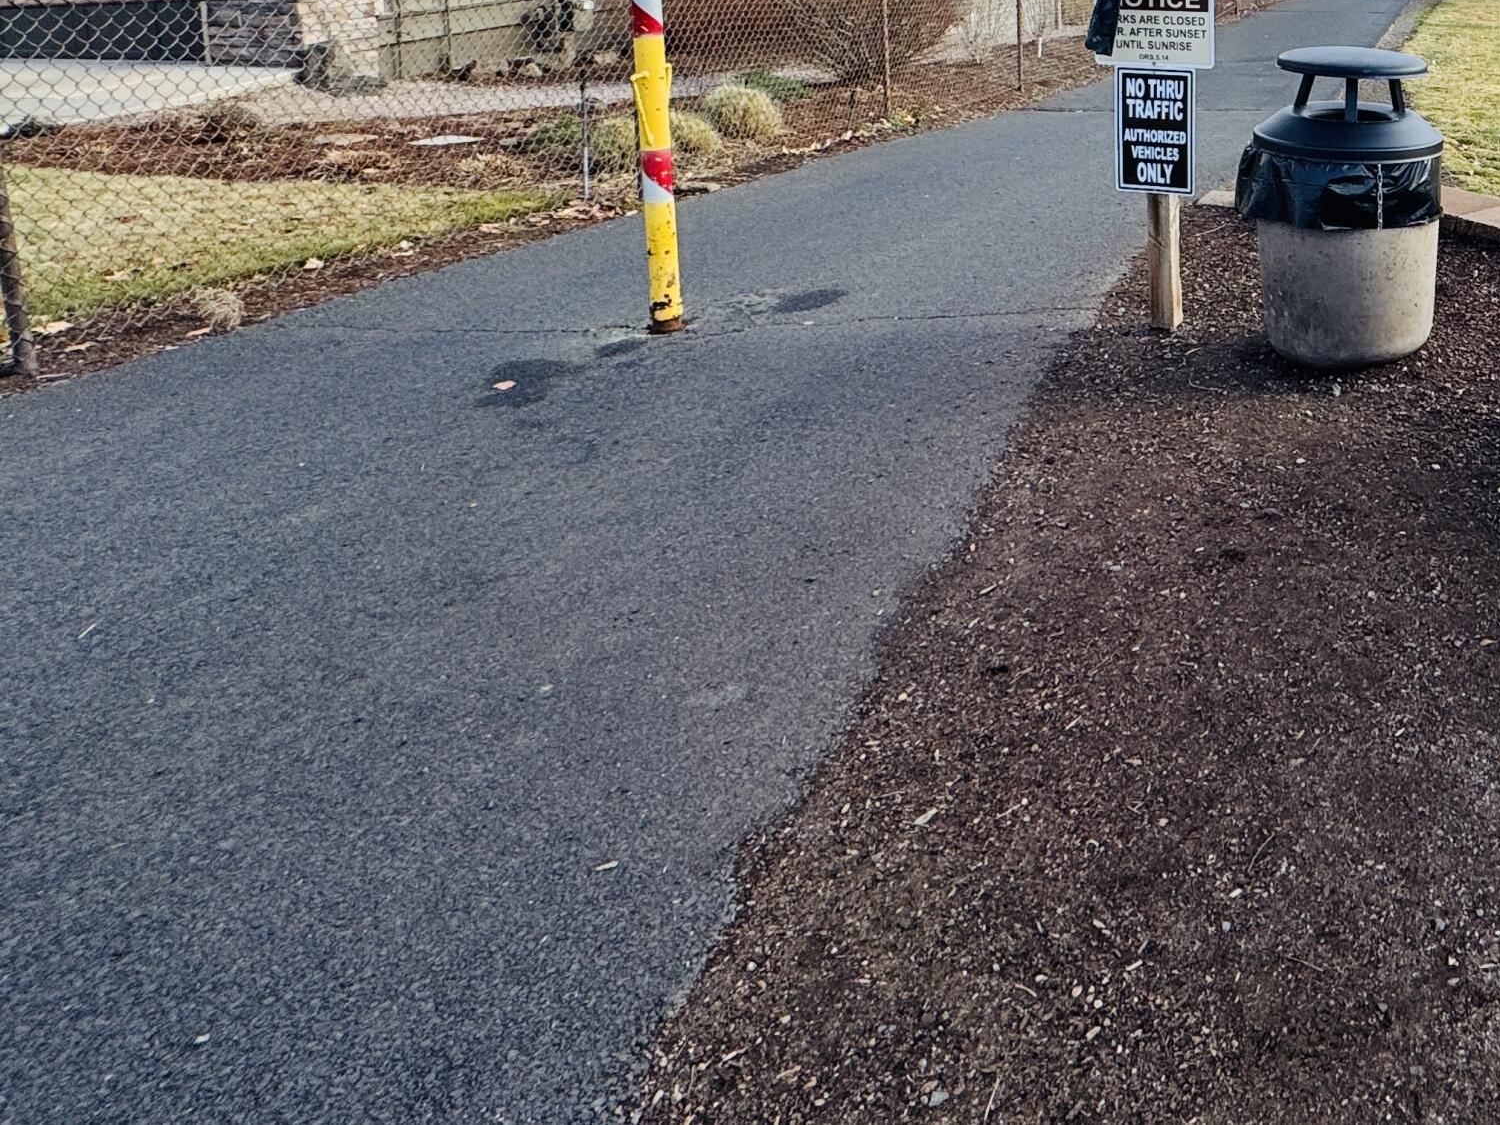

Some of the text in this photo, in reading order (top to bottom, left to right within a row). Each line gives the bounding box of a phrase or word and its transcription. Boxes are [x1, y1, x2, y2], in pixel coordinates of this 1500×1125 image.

[1118, 15, 1206, 26] RKS ARE CLOSED
[1129, 27, 1163, 37] AFTER
[1165, 29, 1207, 39] SUNSET
[1116, 39, 1193, 51] UNTIL SUNRISE
[1126, 78, 1184, 100] NO THRU
[1126, 98, 1184, 121] TRAFFIC
[1124, 128, 1187, 145] AUTHORIZED
[1131, 145, 1180, 162] VEHICLES
[1137, 161, 1174, 184] ONLY
